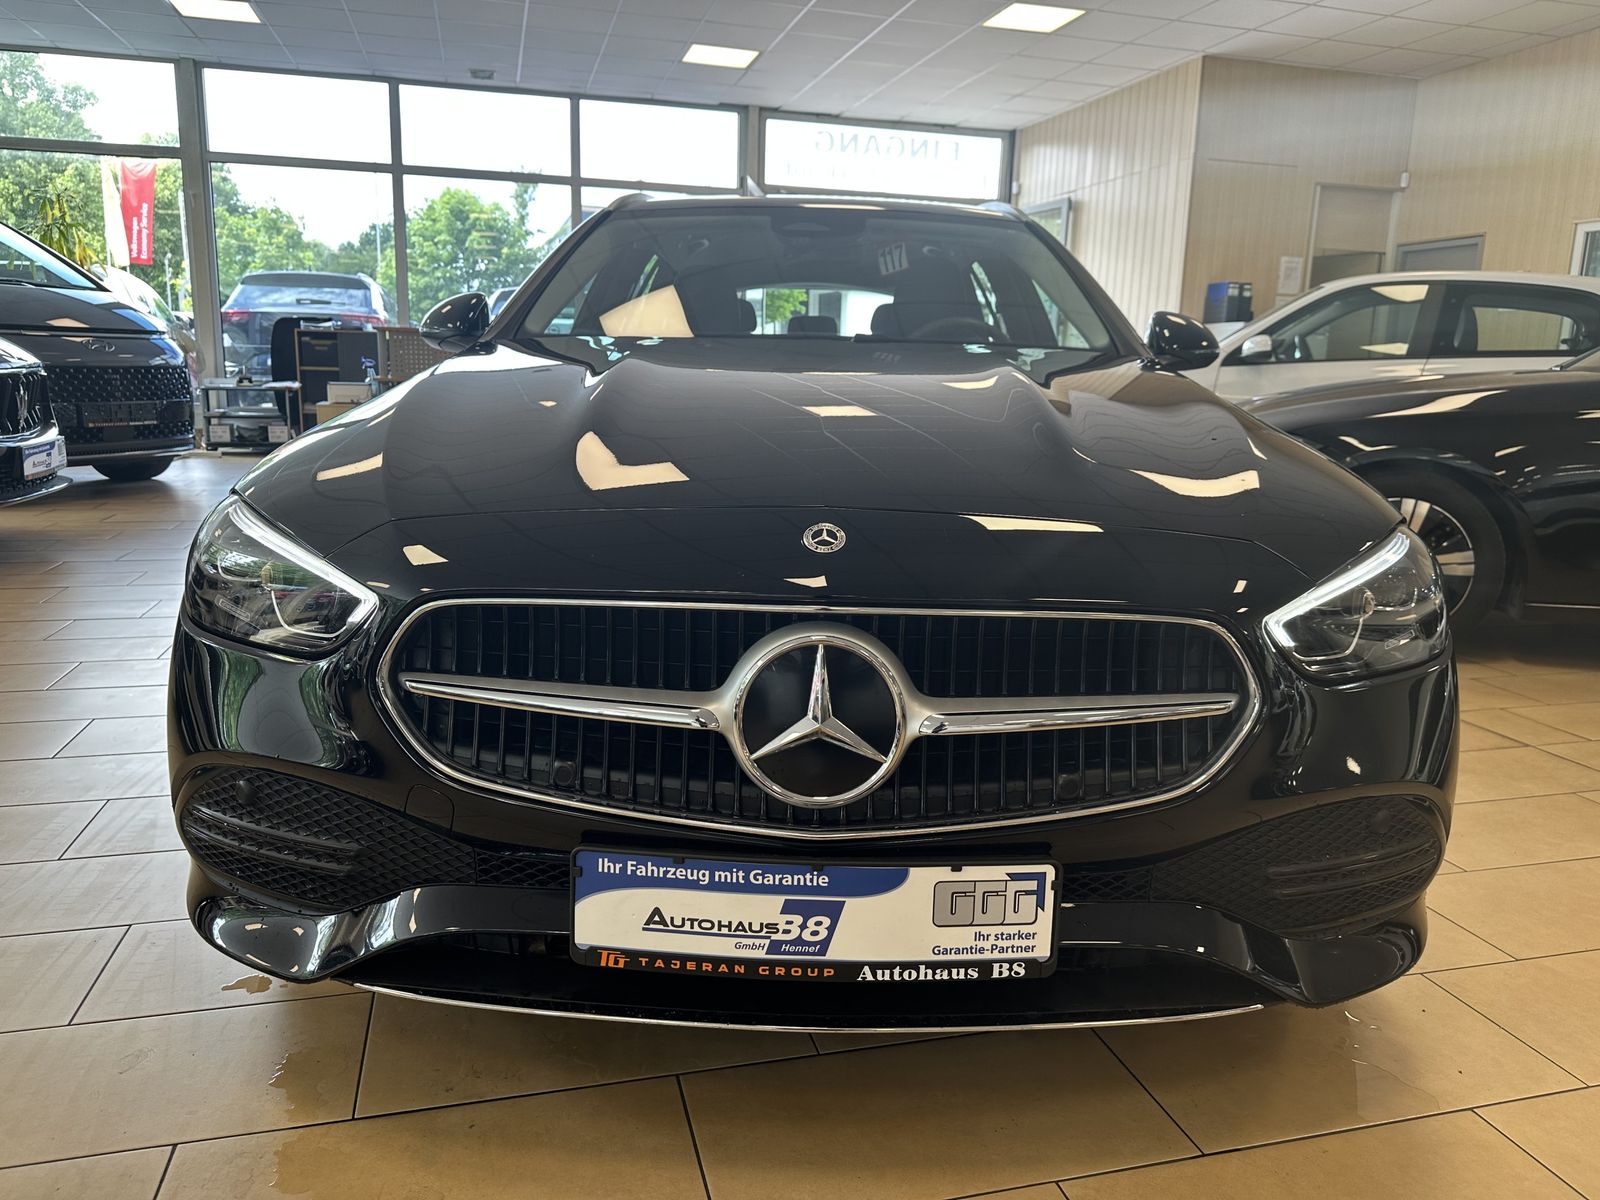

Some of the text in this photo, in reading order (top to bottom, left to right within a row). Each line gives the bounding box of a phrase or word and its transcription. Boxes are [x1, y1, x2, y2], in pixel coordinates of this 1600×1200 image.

[140, 202, 149, 228] Service
[130, 216, 139, 258] Volkswagen
[880, 243, 904, 273] 117
[598, 858, 829, 887] Ihr Fahrzeug mit Garantie
[780, 914, 831, 942] B8
[974, 930, 1037, 942] Ihr starker
[734, 941, 820, 954] GmbH Hennef
[932, 943, 1037, 956] Garantie-Partner
[638, 957, 745, 974] TAJERAN
[758, 965, 835, 978] GROUP
[857, 961, 1026, 981] Autohaus B8
